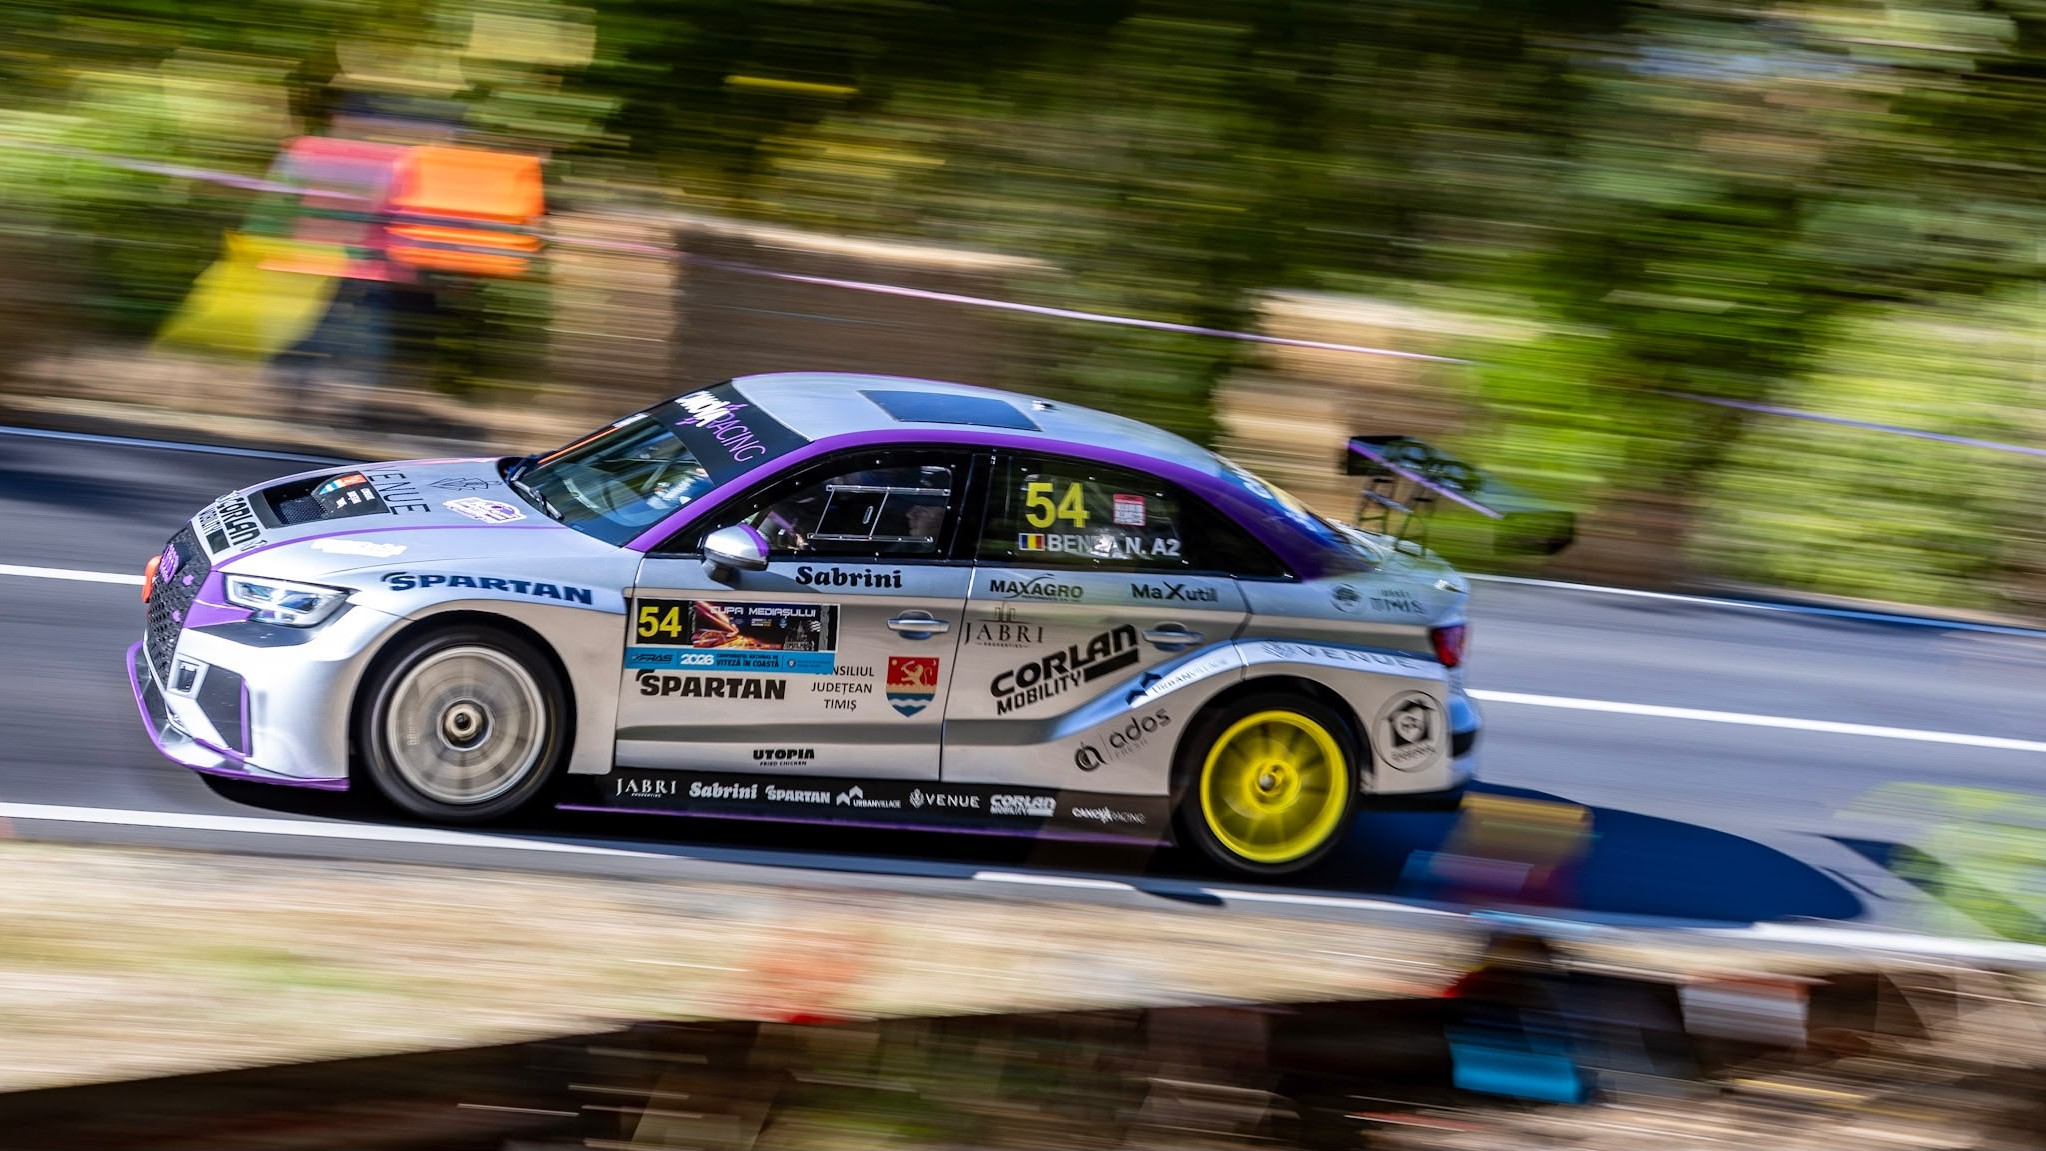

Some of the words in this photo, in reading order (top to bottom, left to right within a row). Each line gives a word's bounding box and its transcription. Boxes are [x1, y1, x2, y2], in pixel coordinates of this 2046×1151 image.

[362, 465, 431, 515] VENUE
[1025, 482, 1090, 528] 54
[1151, 538, 1182, 557] A2
[381, 571, 593, 605] SPARTAN
[795, 566, 903, 589] Sabrini
[990, 576, 1084, 599] MAXAGRO
[1131, 581, 1219, 602] MaXutil
[637, 606, 682, 638] 54
[963, 622, 1044, 645] JABRI
[680, 652, 715, 666] 2026
[990, 623, 1139, 698] CORLAN
[1296, 645, 1420, 670] VENUE
[814, 665, 875, 677] NSILIUL
[635, 669, 786, 700] SPARTAN
[996, 669, 1085, 715] MOBILITY
[1109, 708, 1171, 748] ados
[752, 748, 815, 760] UTOPIA
[616, 777, 677, 796] JABRI
[689, 781, 758, 799] Sabrini
[765, 784, 830, 804] SPARTAN
[925, 793, 980, 808] VENUE
